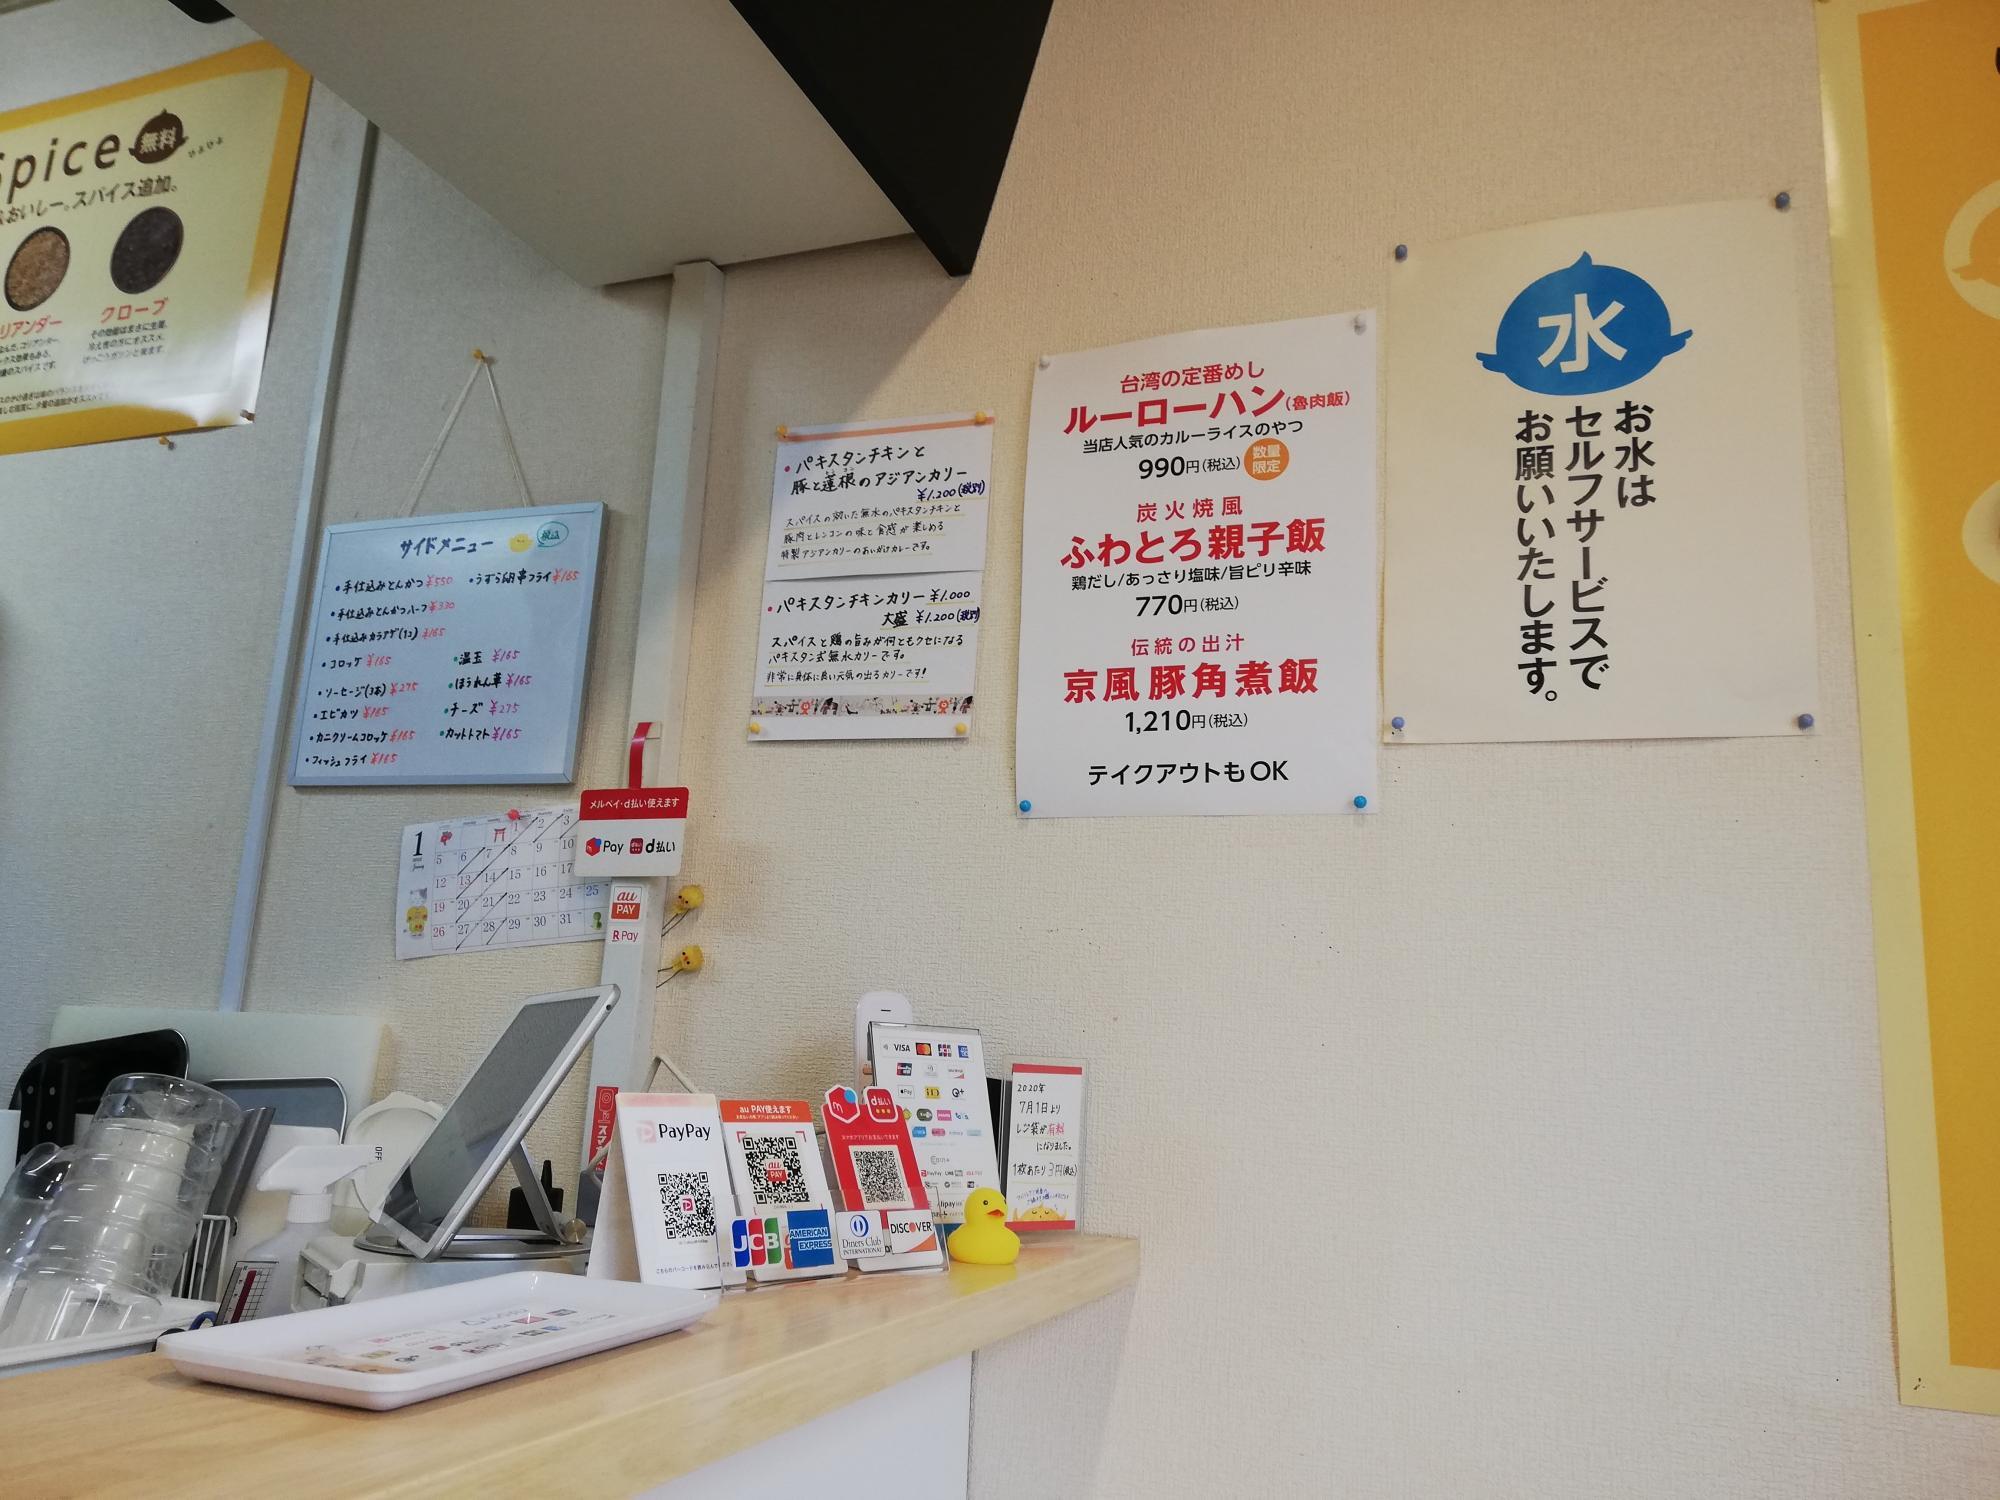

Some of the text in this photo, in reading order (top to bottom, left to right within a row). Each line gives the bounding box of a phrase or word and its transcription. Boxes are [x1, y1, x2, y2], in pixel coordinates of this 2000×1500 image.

[140, 127, 178, 154] 無料
[0, 134, 120, 204] pice
[101, 297, 169, 323] クローブ
[1537, 293, 1628, 374] 水
[1120, 361, 1265, 394] 台湾の定番めし
[1083, 419, 1304, 454] 当店人気のカルーライスのやつ
[795, 446, 926, 474] パキスタンチキンと
[1253, 445, 1281, 459] 数量
[1614, 400, 1657, 509] お水は
[1252, 459, 1281, 474] 限定
[1136, 496, 1243, 523] 炭火焼風
[401, 537, 493, 559] サイドメニュー
[1060, 517, 1326, 570] ふわとろ親子飯
[1564, 405, 1609, 691] セルフサービスで
[1515, 409, 1558, 702] お願いいたします。
[342, 578, 423, 594] 手仕込みとんかつ
[776, 590, 925, 613] パキスタンチキンカリー
[337, 604, 427, 621] 手仕込みとんかつハーフ
[882, 610, 909, 628] 大盛
[1131, 633, 1245, 656] 伝統の出汁
[330, 657, 362, 669] コロッケ
[459, 651, 483, 666] 温玉
[455, 671, 502, 690] ほうれん草
[1063, 658, 1319, 704] 京風豚角煮飯
[320, 708, 359, 720] エビカツ
[450, 702, 484, 717] チーズ
[316, 730, 388, 743] カニクリームコロッケ
[445, 727, 490, 741] カットトマト
[312, 754, 367, 767] フィッシュフライ
[1088, 760, 1289, 786] テイクアウトもOK
[562, 838, 574, 849] 10
[603, 840, 624, 855] Pay
[645, 838, 676, 853] d払い
[435, 862, 573, 889] 12 13 14 15 16 17
[433, 884, 599, 913] 19 20 21 22 23 24 25
[617, 890, 637, 901] au
[616, 904, 635, 914] PAY
[432, 913, 572, 938] 26 27 28 29 30 31
[621, 931, 638, 943] Pay
[894, 1044, 910, 1052] VISA
[1017, 1083, 1046, 1094] 2020年
[658, 1124, 711, 1141] PayPay
[770, 1170, 783, 1178] PAY
[789, 1229, 828, 1239] AMERICAN
[842, 1236, 881, 1248] Diners Club
[799, 1240, 832, 1249] EXPRESS
